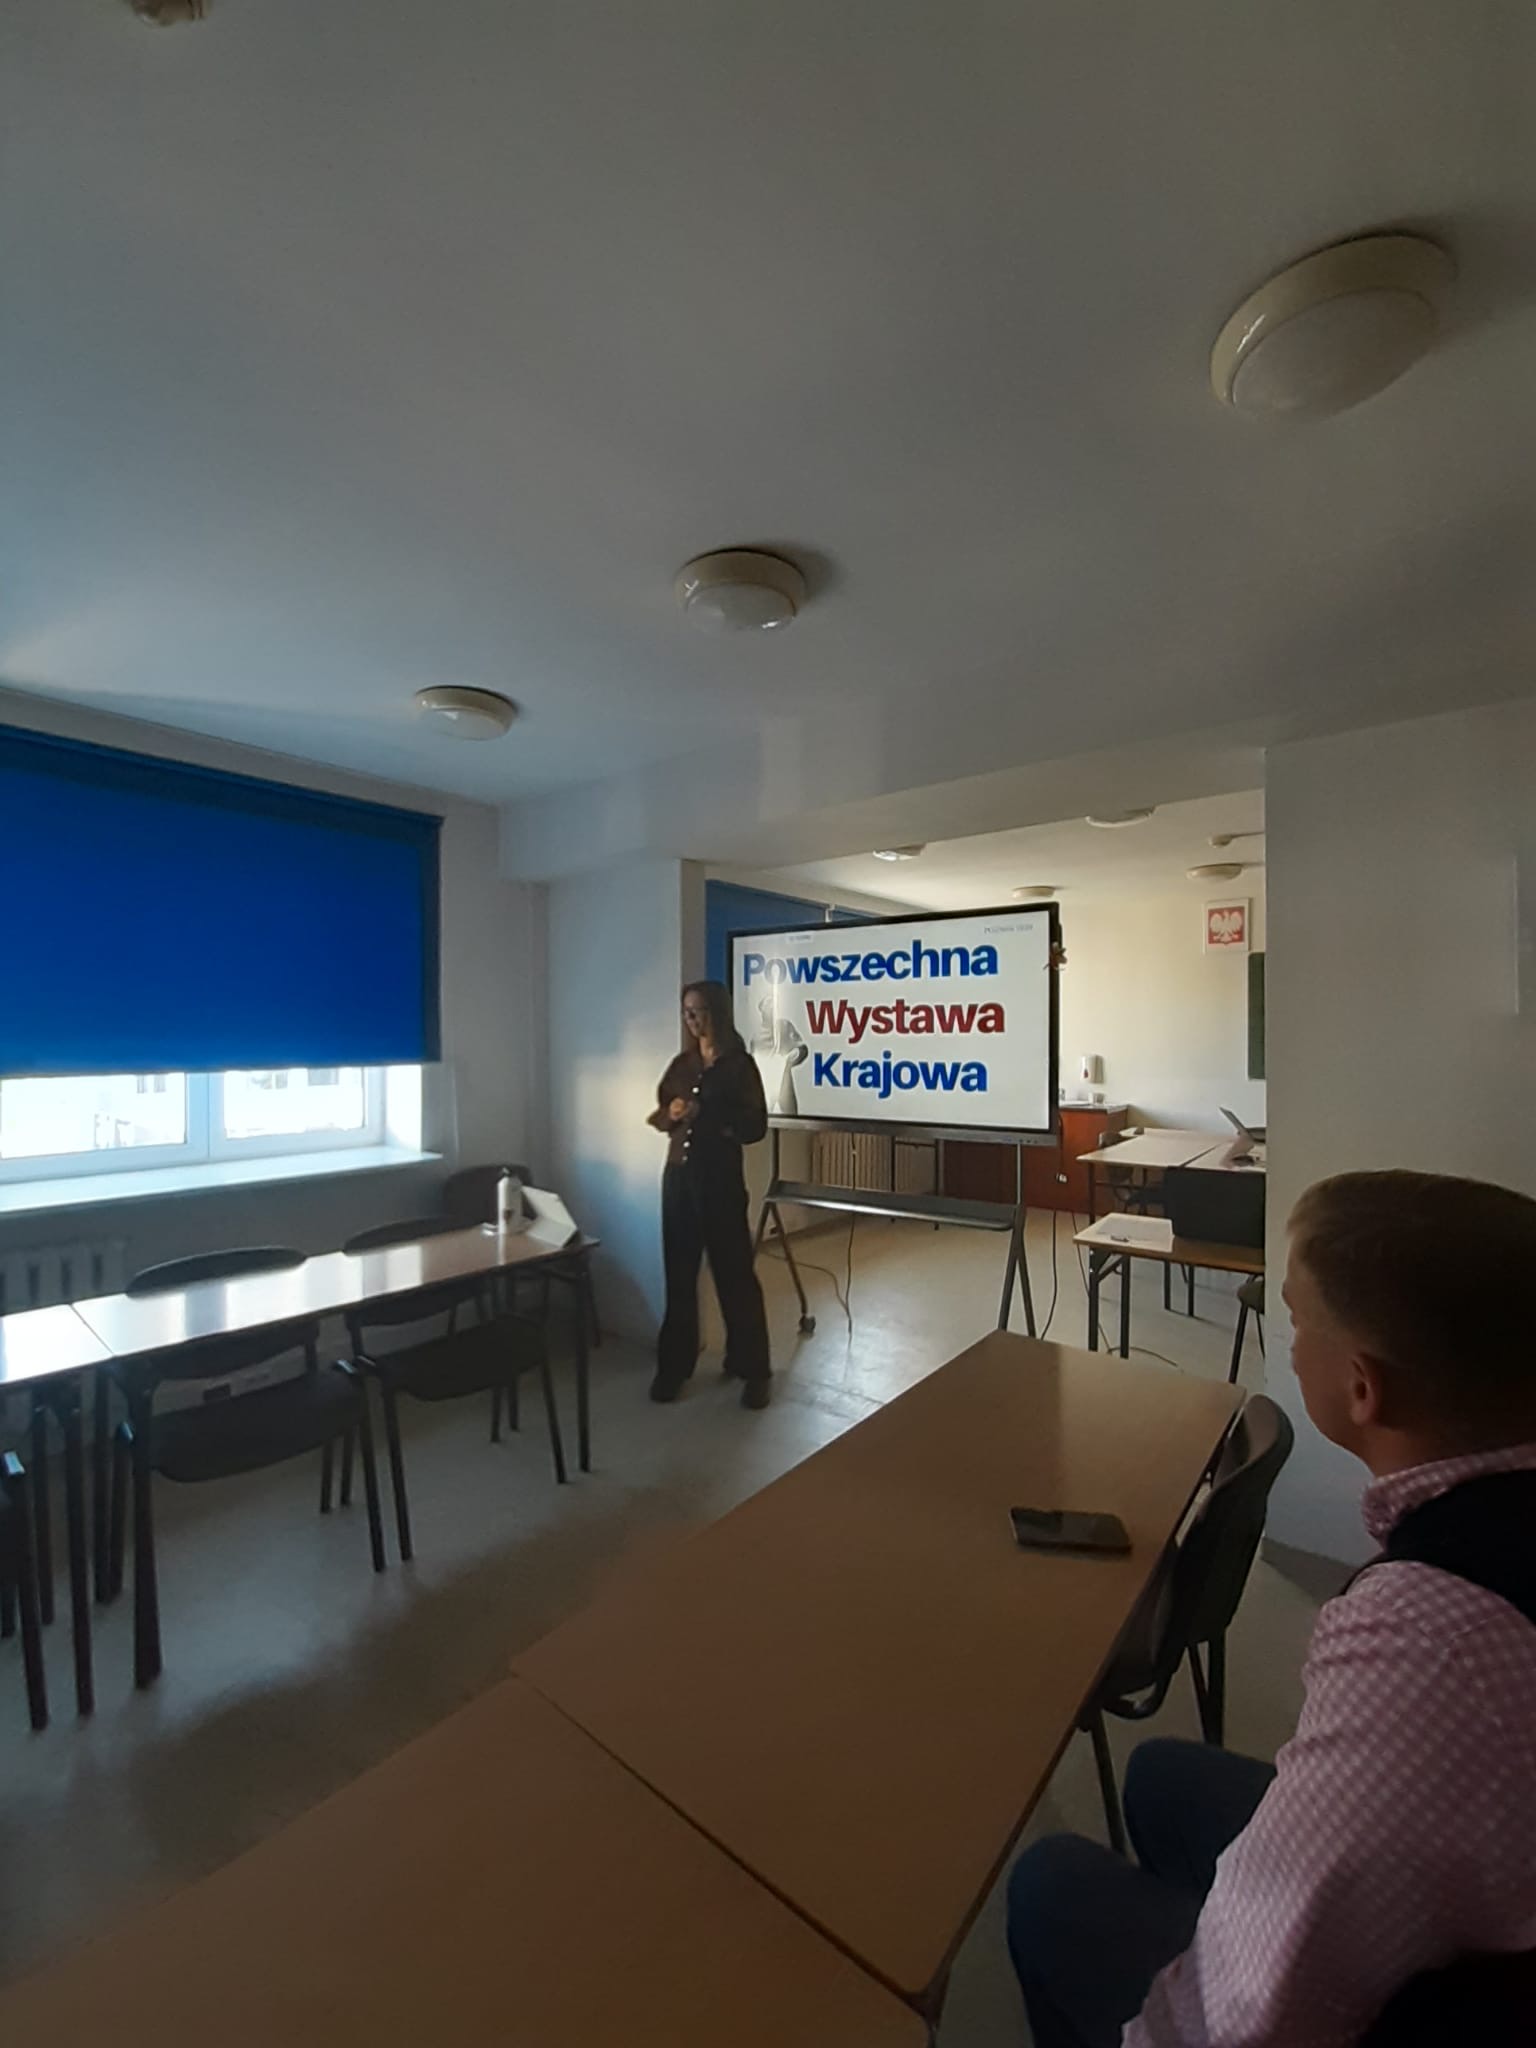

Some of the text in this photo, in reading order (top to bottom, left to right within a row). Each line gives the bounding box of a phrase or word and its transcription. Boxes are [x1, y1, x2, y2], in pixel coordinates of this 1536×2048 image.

[743, 940, 998, 986] Powszechna
[806, 999, 1005, 1043] Wystawa
[813, 1051, 987, 1098] Krajowa
